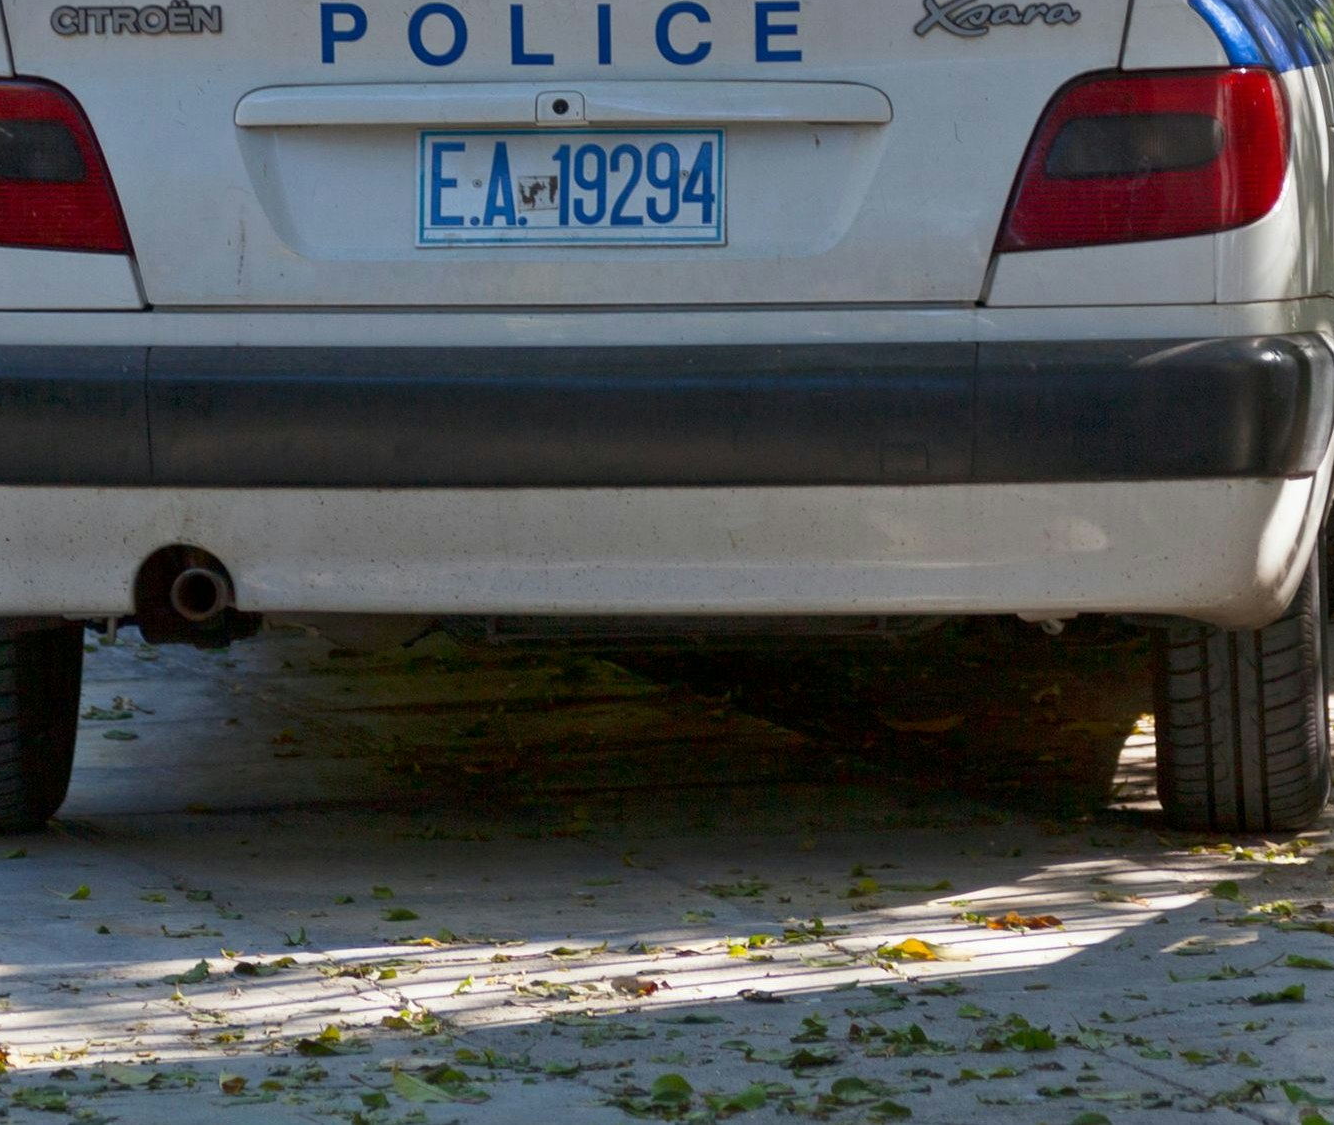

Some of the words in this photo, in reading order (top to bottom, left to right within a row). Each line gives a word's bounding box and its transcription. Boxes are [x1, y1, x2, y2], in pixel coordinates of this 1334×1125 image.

[50, 0, 222, 35] CITROËN
[320, 1, 802, 66] POLICE
[552, 141, 715, 226] 19294
